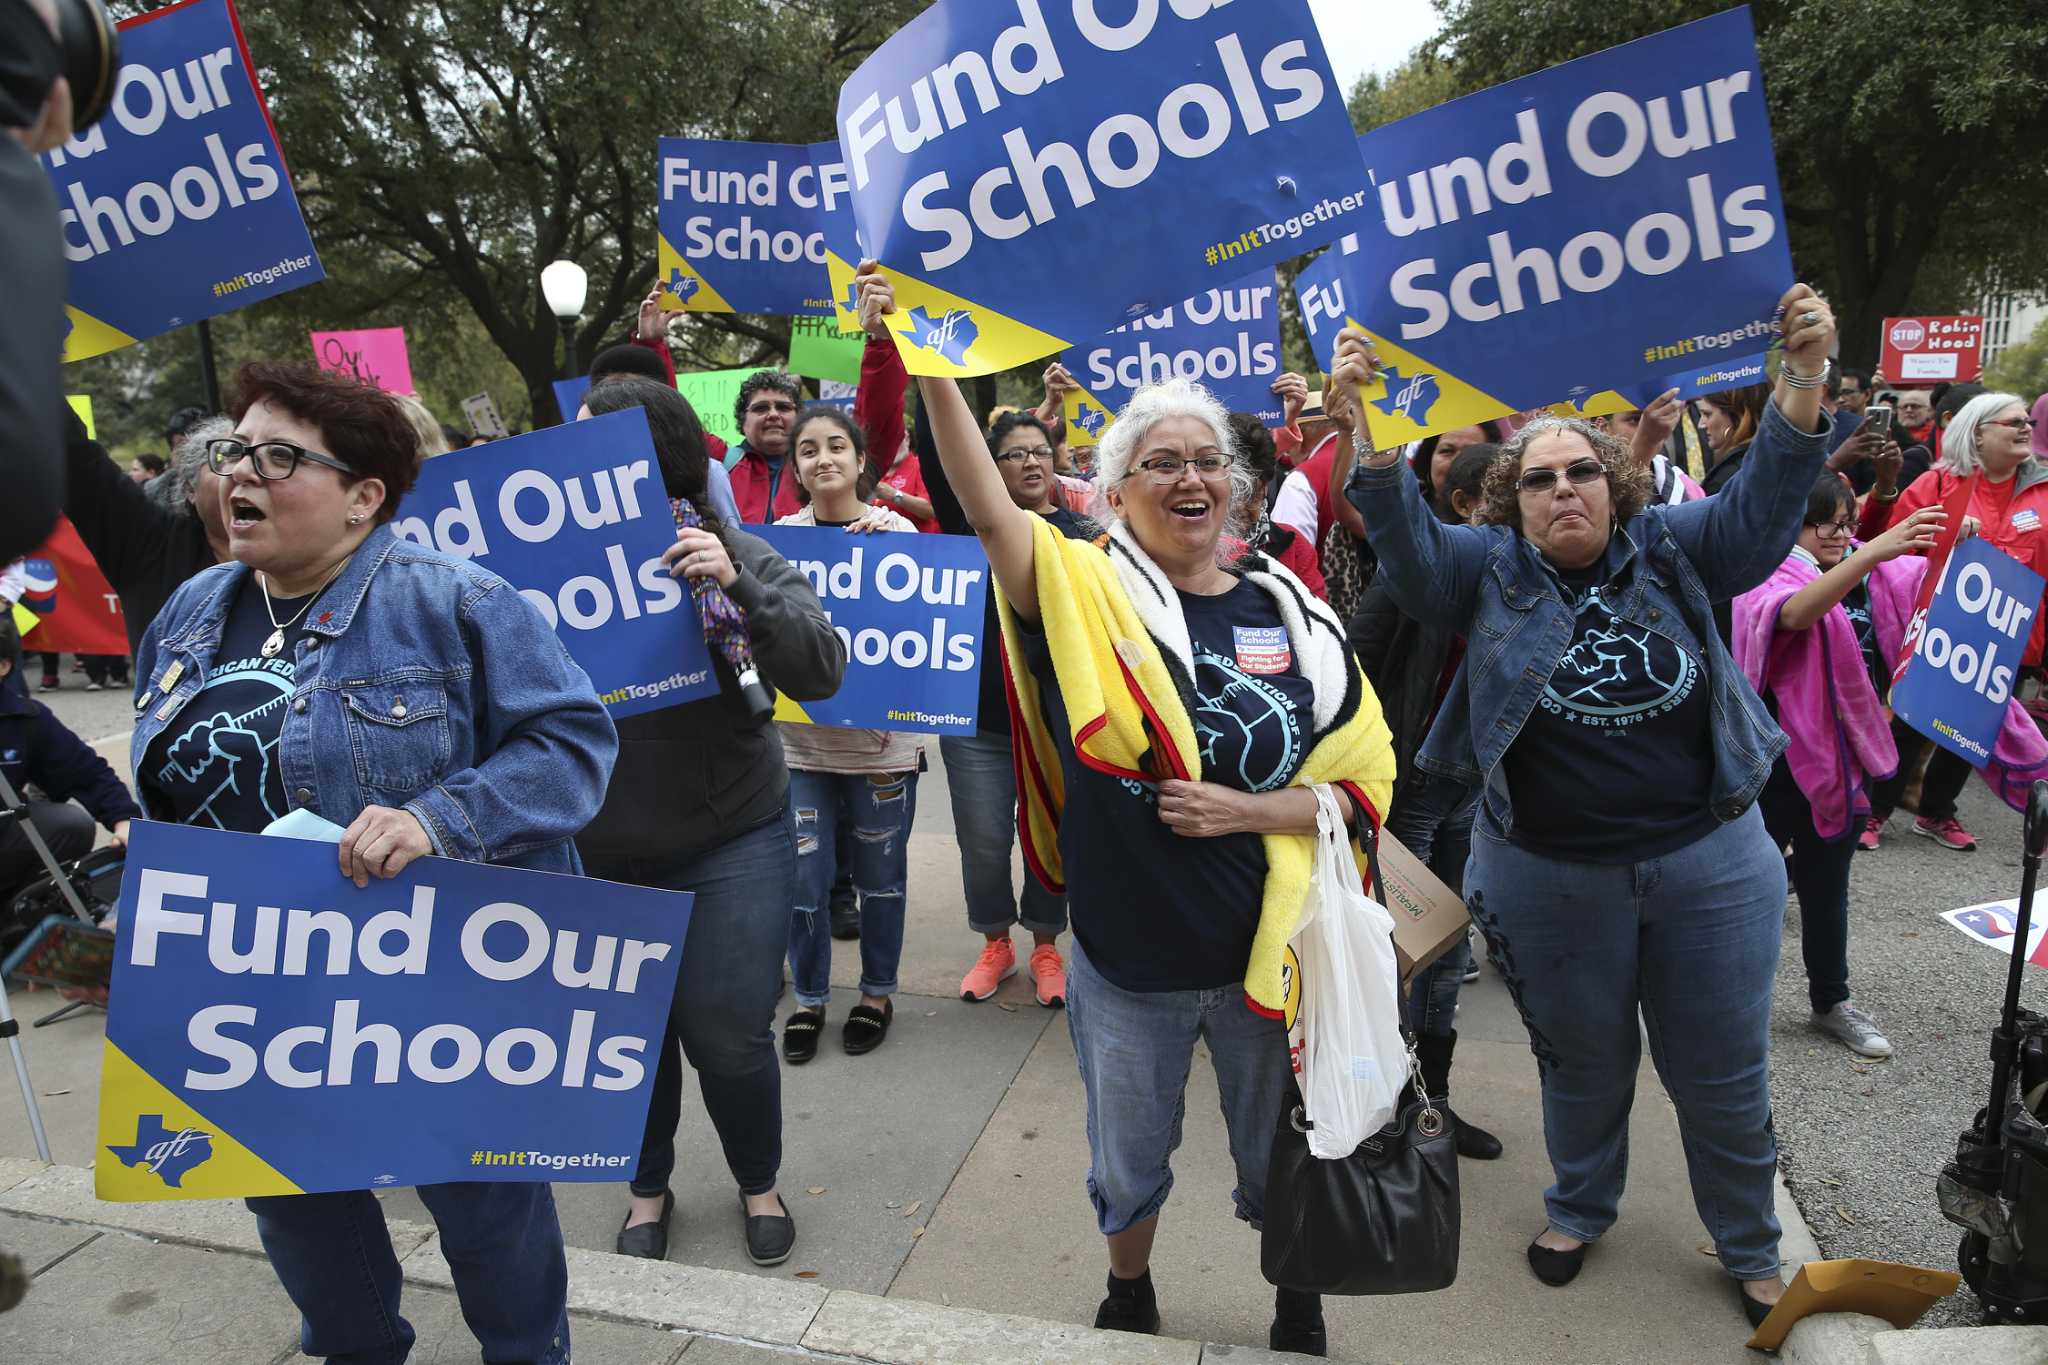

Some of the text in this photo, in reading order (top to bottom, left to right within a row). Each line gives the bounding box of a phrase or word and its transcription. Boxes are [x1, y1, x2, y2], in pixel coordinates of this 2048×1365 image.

[112, 47, 232, 136] Our
[846, 0, 1064, 190] Fund
[903, 33, 1324, 272] Schools
[1341, 70, 1752, 255] und Our
[60, 133, 279, 262] chools
[663, 158, 777, 206] Fund
[1204, 188, 1365, 267] #InItTogether
[213, 254, 312, 297] #InItTogether
[1389, 173, 1776, 340] Schools
[1183, 286, 1272, 325] Our
[1893, 320, 1980, 341] STOP Robin
[1088, 332, 1276, 391] Schools
[1644, 317, 1783, 364] #InItTogethe
[1928, 334, 1975, 349] Hood
[498, 460, 649, 543] Our
[875, 552, 982, 606] Our
[1956, 562, 2032, 639] Our
[1236, 629, 1260, 637] Fund
[1240, 636, 1280, 644] Schools
[887, 709, 972, 726] #InItTogether
[1288, 713, 1300, 736] OF
[1582, 716, 1609, 727] EST.
[131, 869, 672, 994] Fund Our
[184, 1000, 648, 1091] Schools
[145, 1128, 215, 1175] aft
[470, 1150, 631, 1169] #InItTogether
